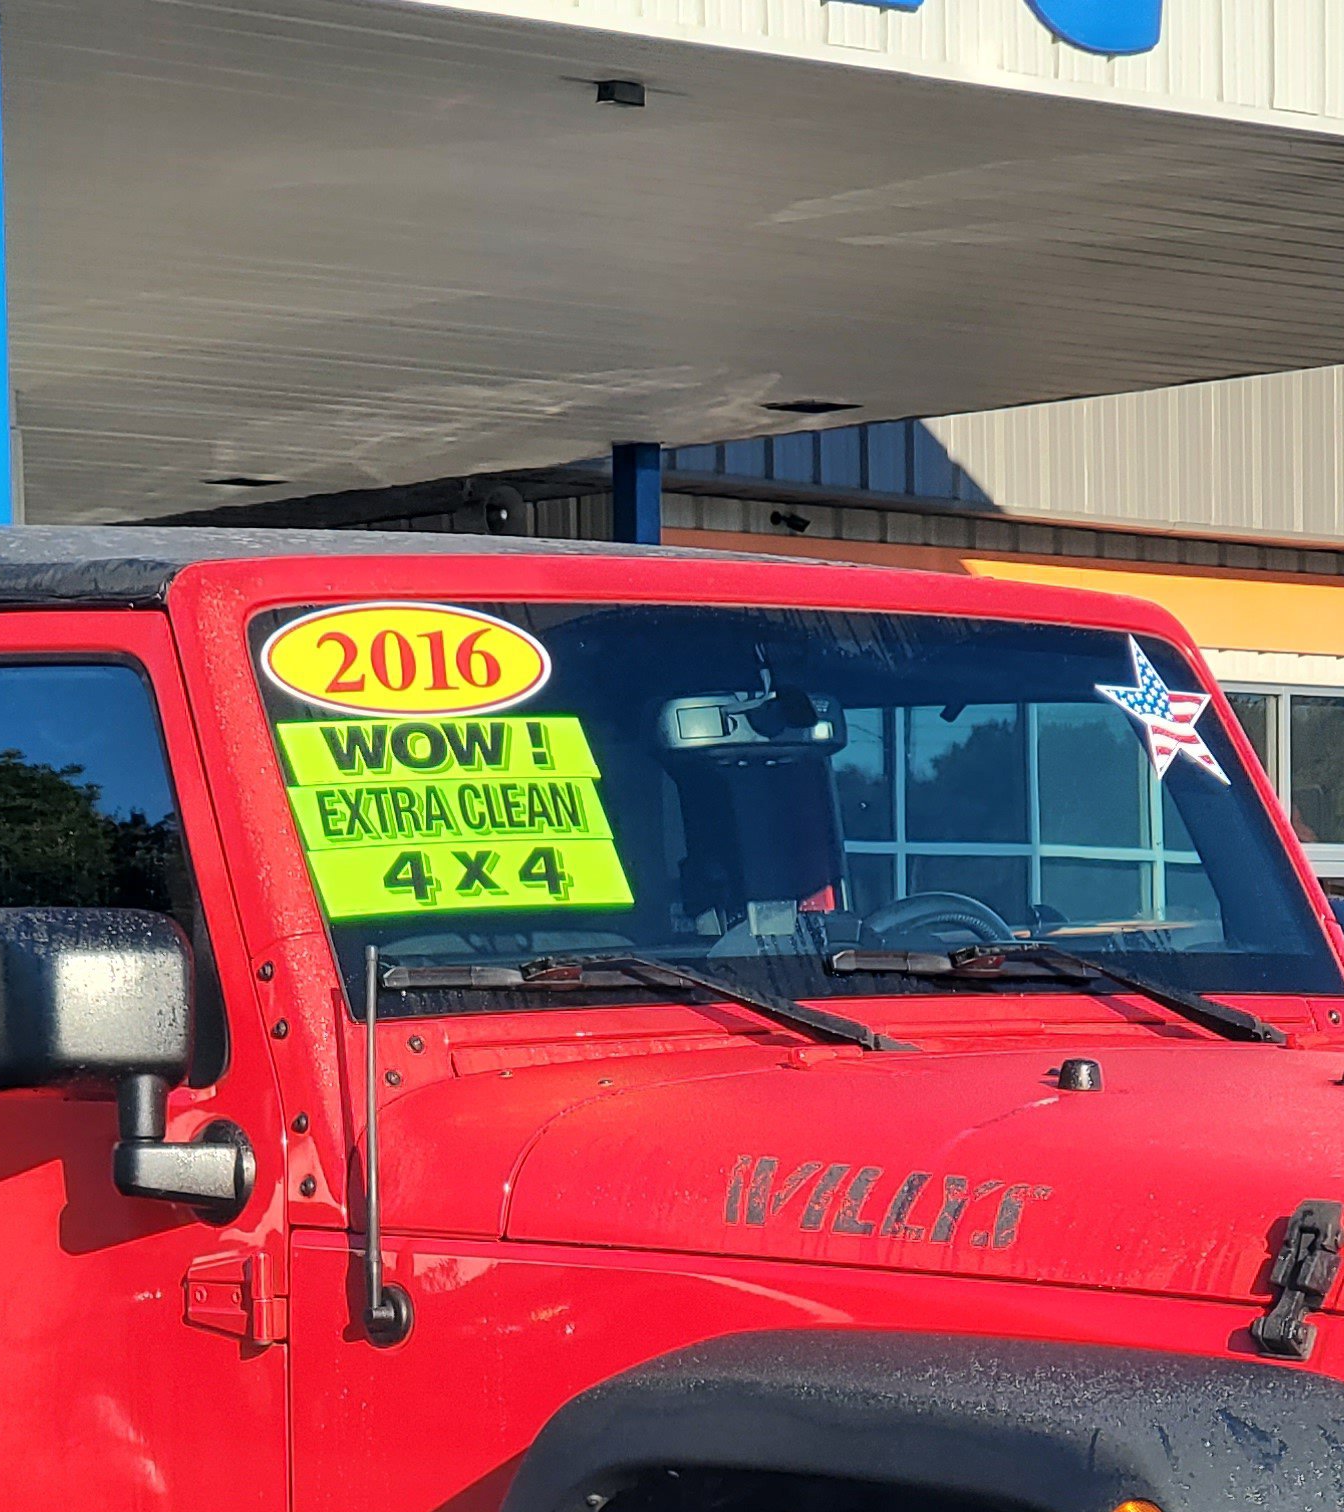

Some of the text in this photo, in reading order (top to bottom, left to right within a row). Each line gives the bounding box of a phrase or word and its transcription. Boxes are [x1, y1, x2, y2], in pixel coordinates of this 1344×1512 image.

[316, 627, 501, 694] 2016
[316, 782, 588, 842] EXTRA CLEAN
